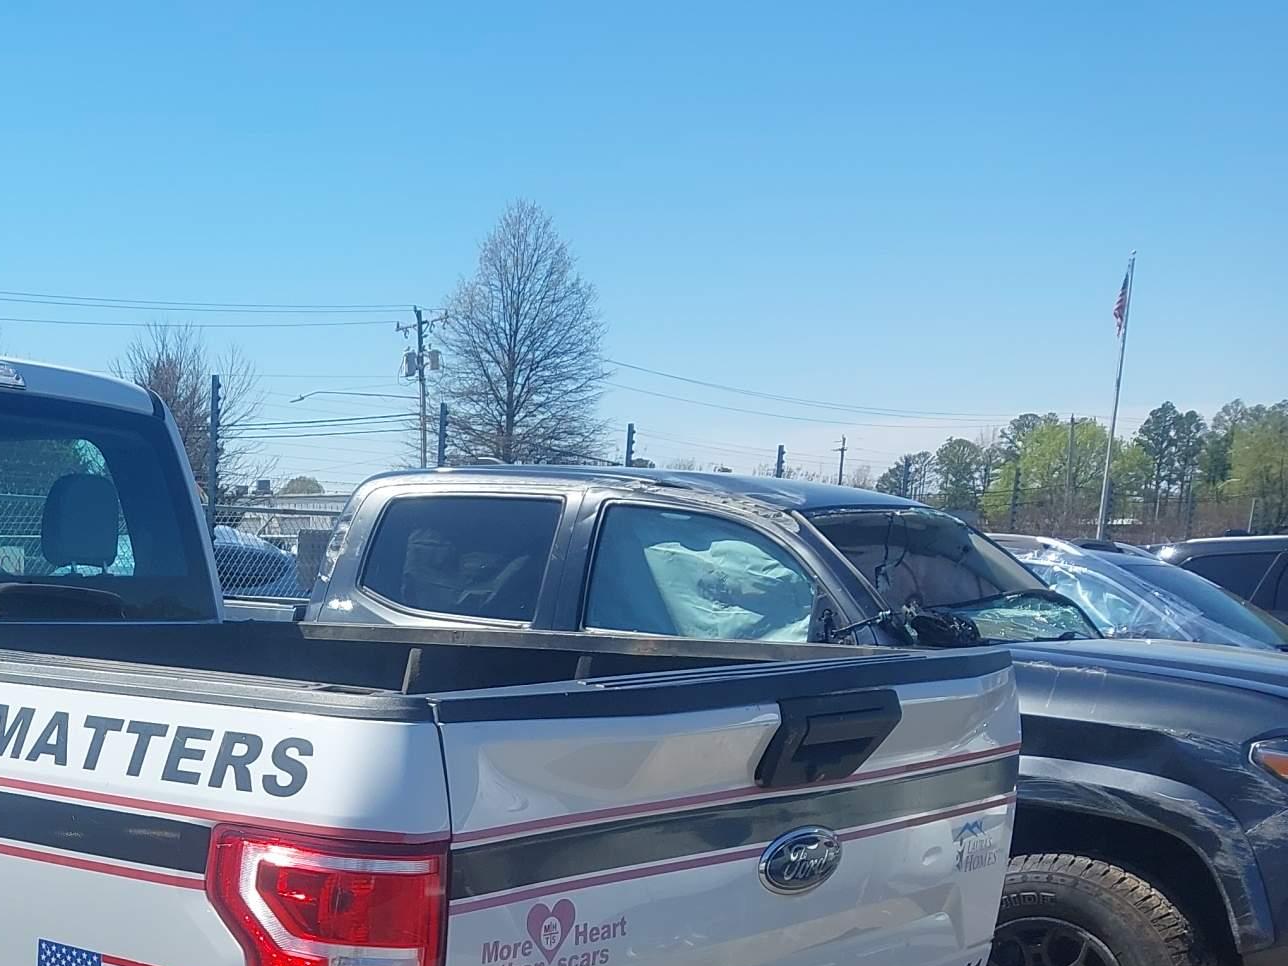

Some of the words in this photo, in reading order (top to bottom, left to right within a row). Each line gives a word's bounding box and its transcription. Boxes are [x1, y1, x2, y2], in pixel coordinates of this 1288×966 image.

[783, 843, 829, 881] Ford
[481, 939, 533, 965] More
[574, 916, 628, 945] Heart
